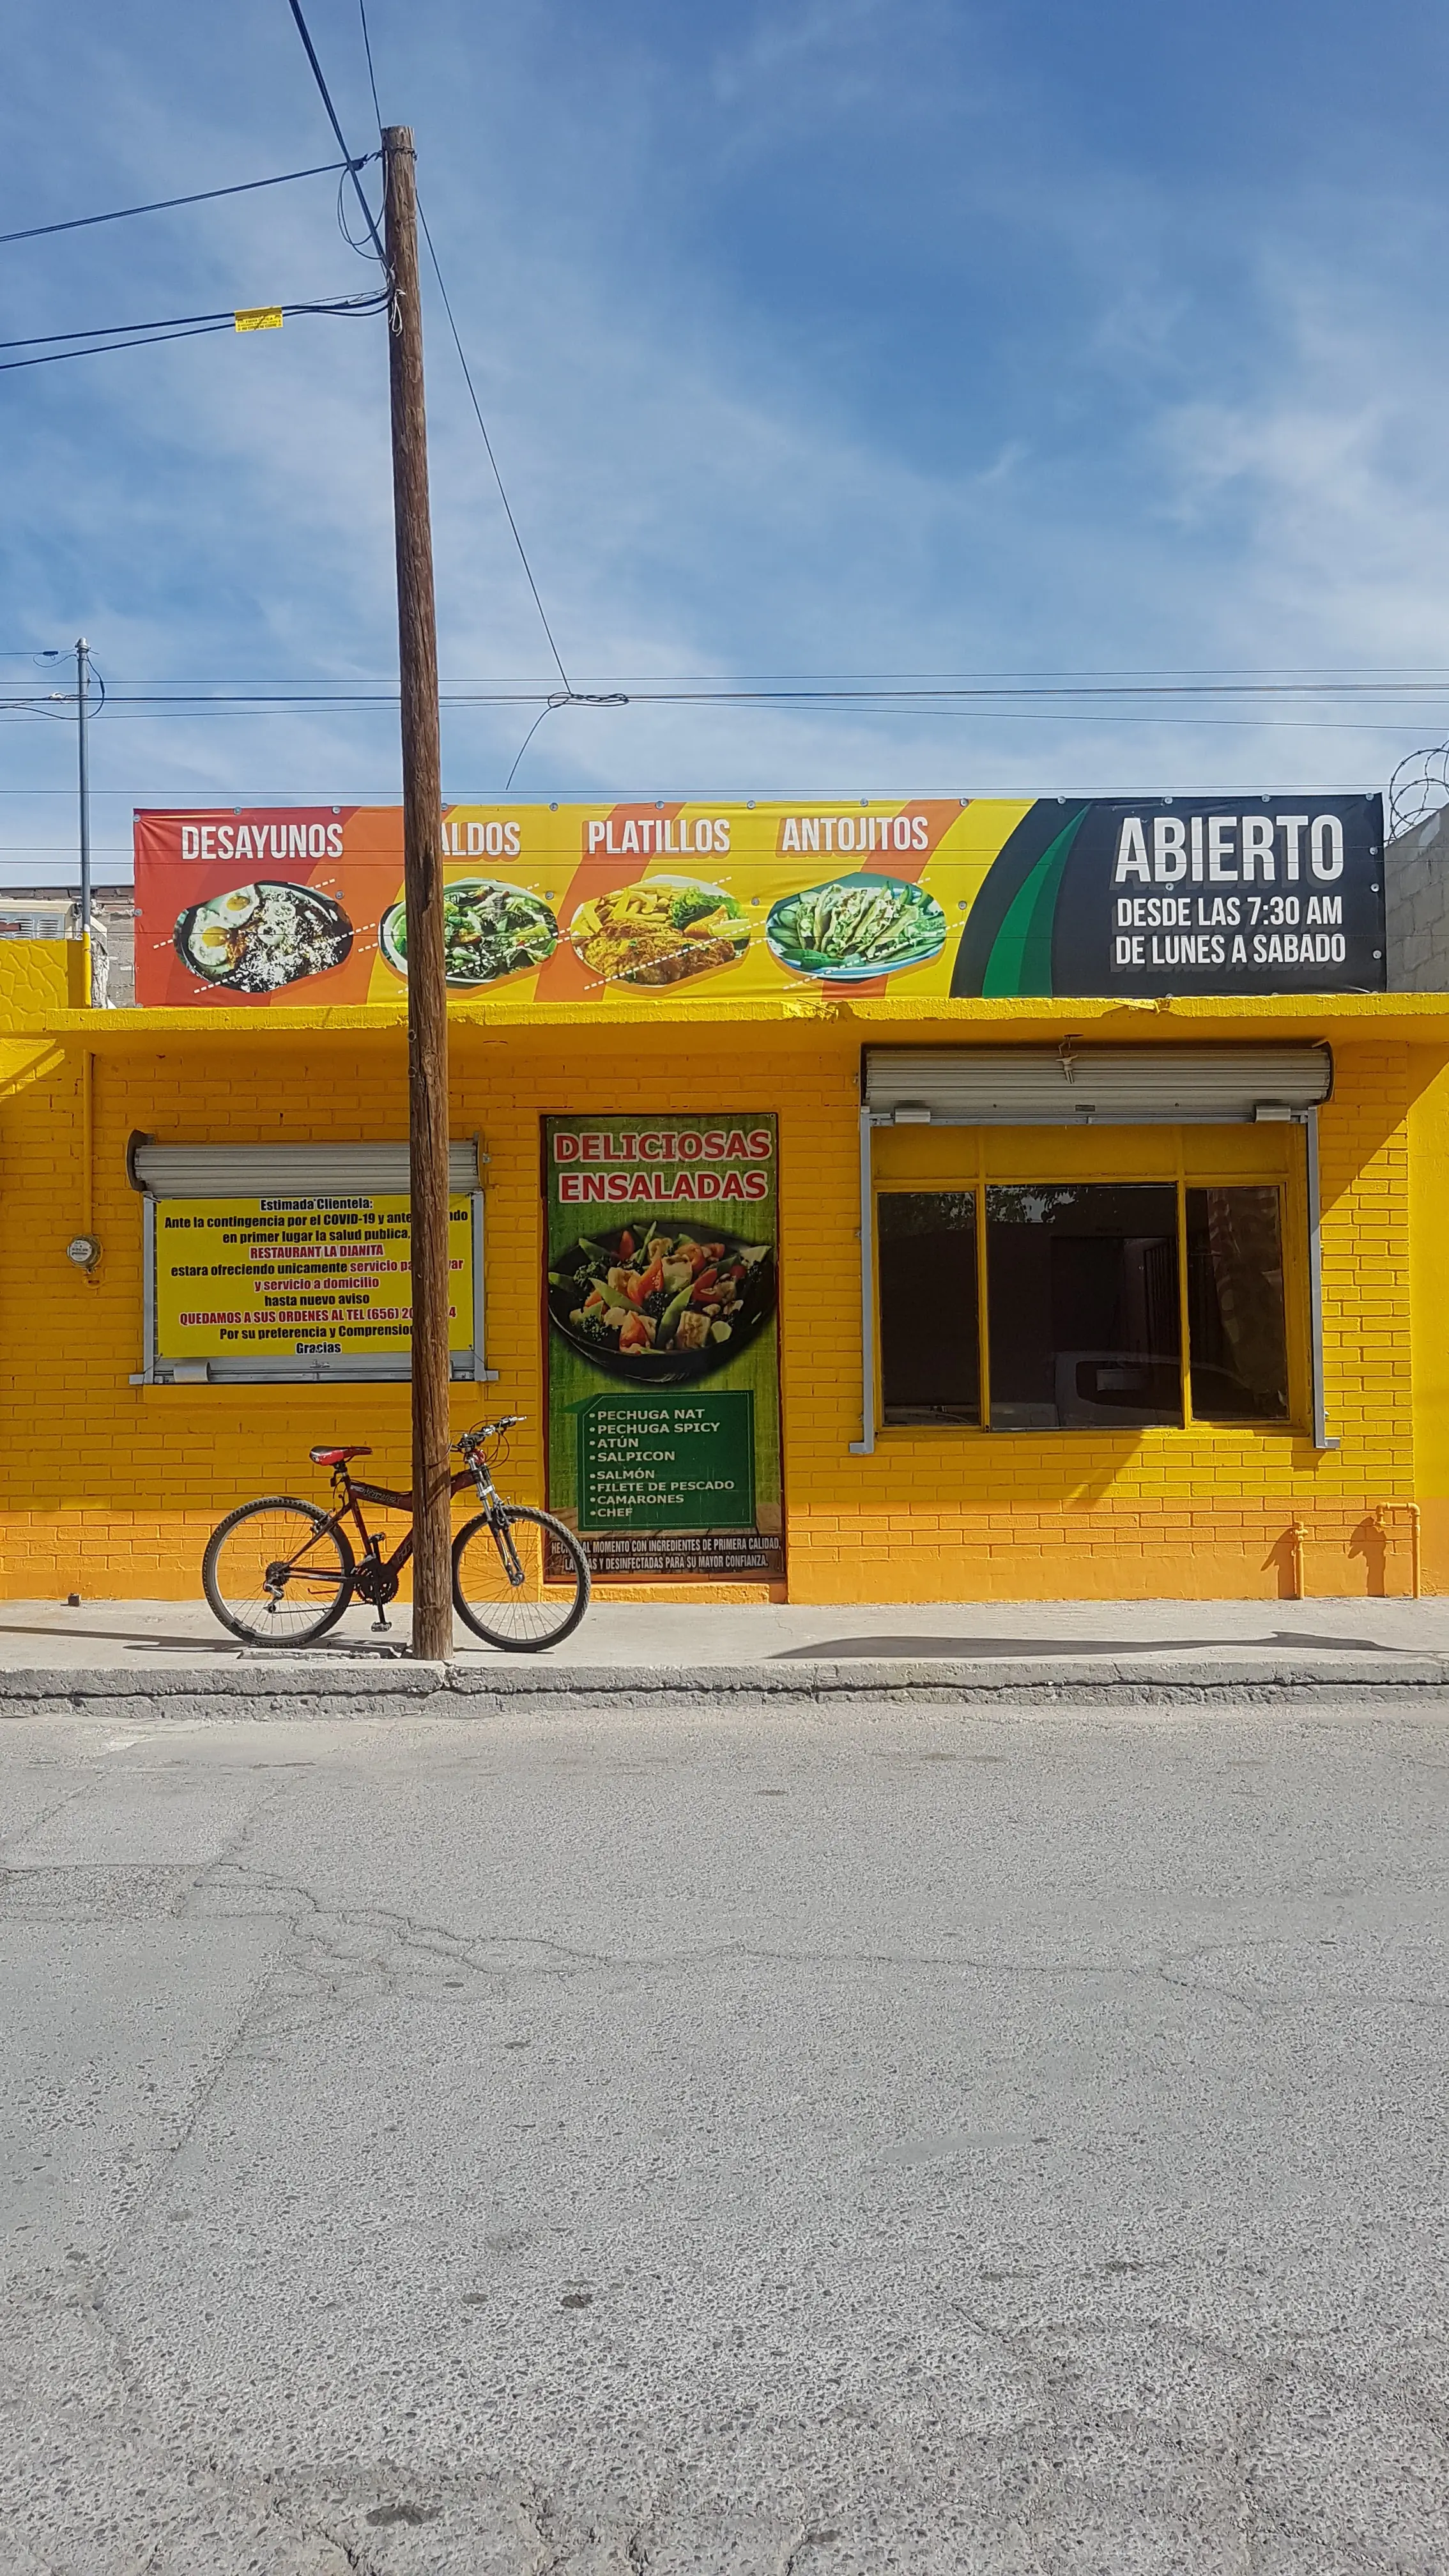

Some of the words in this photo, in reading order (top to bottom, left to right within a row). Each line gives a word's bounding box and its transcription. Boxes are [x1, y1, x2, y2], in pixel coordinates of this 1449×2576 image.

[181, 822, 344, 861] DESAYUNOS
[588, 819, 731, 854] PLATILLOS
[782, 816, 929, 852] ANTOJITOS
[1115, 815, 1344, 883] ABIERTO
[1117, 898, 1192, 926] DESDE
[1199, 897, 1241, 926] LAS
[1247, 896, 1300, 926] 7:30
[1307, 896, 1342, 925] AM
[1116, 935, 1145, 965] DE
[1152, 935, 1225, 964] LUNES
[1232, 935, 1247, 963] A
[1253, 933, 1346, 963] SABADO
[555, 1130, 771, 1162] DELICIOSAS
[560, 1172, 767, 1202] ENSALADAS
[261, 1199, 314, 1211] Estimada
[317, 1197, 373, 1209] Clientela:
[165, 1217, 190, 1228] Ante
[194, 1216, 204, 1227] la
[207, 1215, 285, 1228] contingencia
[288, 1216, 307, 1227] por
[310, 1215, 321, 1225] el
[323, 1213, 375, 1225] COVID-19
[378, 1215, 385, 1225] y
[387, 1213, 411, 1223] ante
[223, 1233, 237, 1243] en
[240, 1232, 279, 1244] primer
[282, 1230, 313, 1243] lugar
[316, 1230, 326, 1241] la
[329, 1229, 362, 1241] salud
[250, 1246, 321, 1259] RESTAURANT
[324, 1245, 337, 1257] LA
[340, 1244, 384, 1257] DIANITA
[171, 1265, 208, 1276] estara
[211, 1263, 275, 1276] ofreciendo
[277, 1262, 348, 1275] unicamente
[350, 1260, 397, 1272] servicio
[254, 1282, 261, 1292] y
[264, 1279, 311, 1291] servicio
[314, 1280, 321, 1289] a
[323, 1277, 379, 1289] domicilio
[264, 1295, 297, 1307] hasta
[300, 1296, 335, 1306] nuevo
[338, 1293, 370, 1305] aviso
[180, 1312, 241, 1325] QUEDAMOS
[243, 1312, 252, 1323] A
[254, 1311, 276, 1322] SUS
[279, 1310, 329, 1322] ORDENES
[331, 1310, 344, 1321] AL
[346, 1309, 365, 1321] TEL
[367, 1307, 399, 1321] (656)
[220, 1328, 240, 1340] Por
[241, 1329, 255, 1339] su
[258, 1326, 327, 1340] preferencia
[330, 1328, 336, 1338] y
[296, 1341, 341, 1354] Gracias
[597, 1409, 670, 1420] PECHUGA
[674, 1409, 705, 1420] NAT
[597, 1423, 670, 1434] PECHUGA
[674, 1422, 720, 1433] SPICY
[597, 1436, 639, 1448] ATÚN
[597, 1451, 675, 1462] SALPICON
[597, 1468, 655, 1480] SALMÓN
[597, 1482, 643, 1492] FILETE
[648, 1482, 666, 1491] DE
[670, 1480, 734, 1491] PESCADO
[597, 1494, 684, 1505] CAMARONES
[597, 1508, 633, 1517] CHEF
[583, 1542, 590, 1553] AL
[593, 1540, 629, 1553] MOMENTO
[631, 1540, 647, 1552] CON
[649, 1538, 701, 1552] INGREDIENTES
[703, 1538, 712, 1551] DE
[714, 1538, 747, 1550] PRIMERA
[599, 1558, 604, 1569] Y
[606, 1556, 663, 1570] DESINFECTADAS
[666, 1556, 684, 1568] PARA
[687, 1556, 696, 1568] SU
[698, 1555, 723, 1567] MAYOR
[725, 1554, 768, 1567] CONFIANZA.
